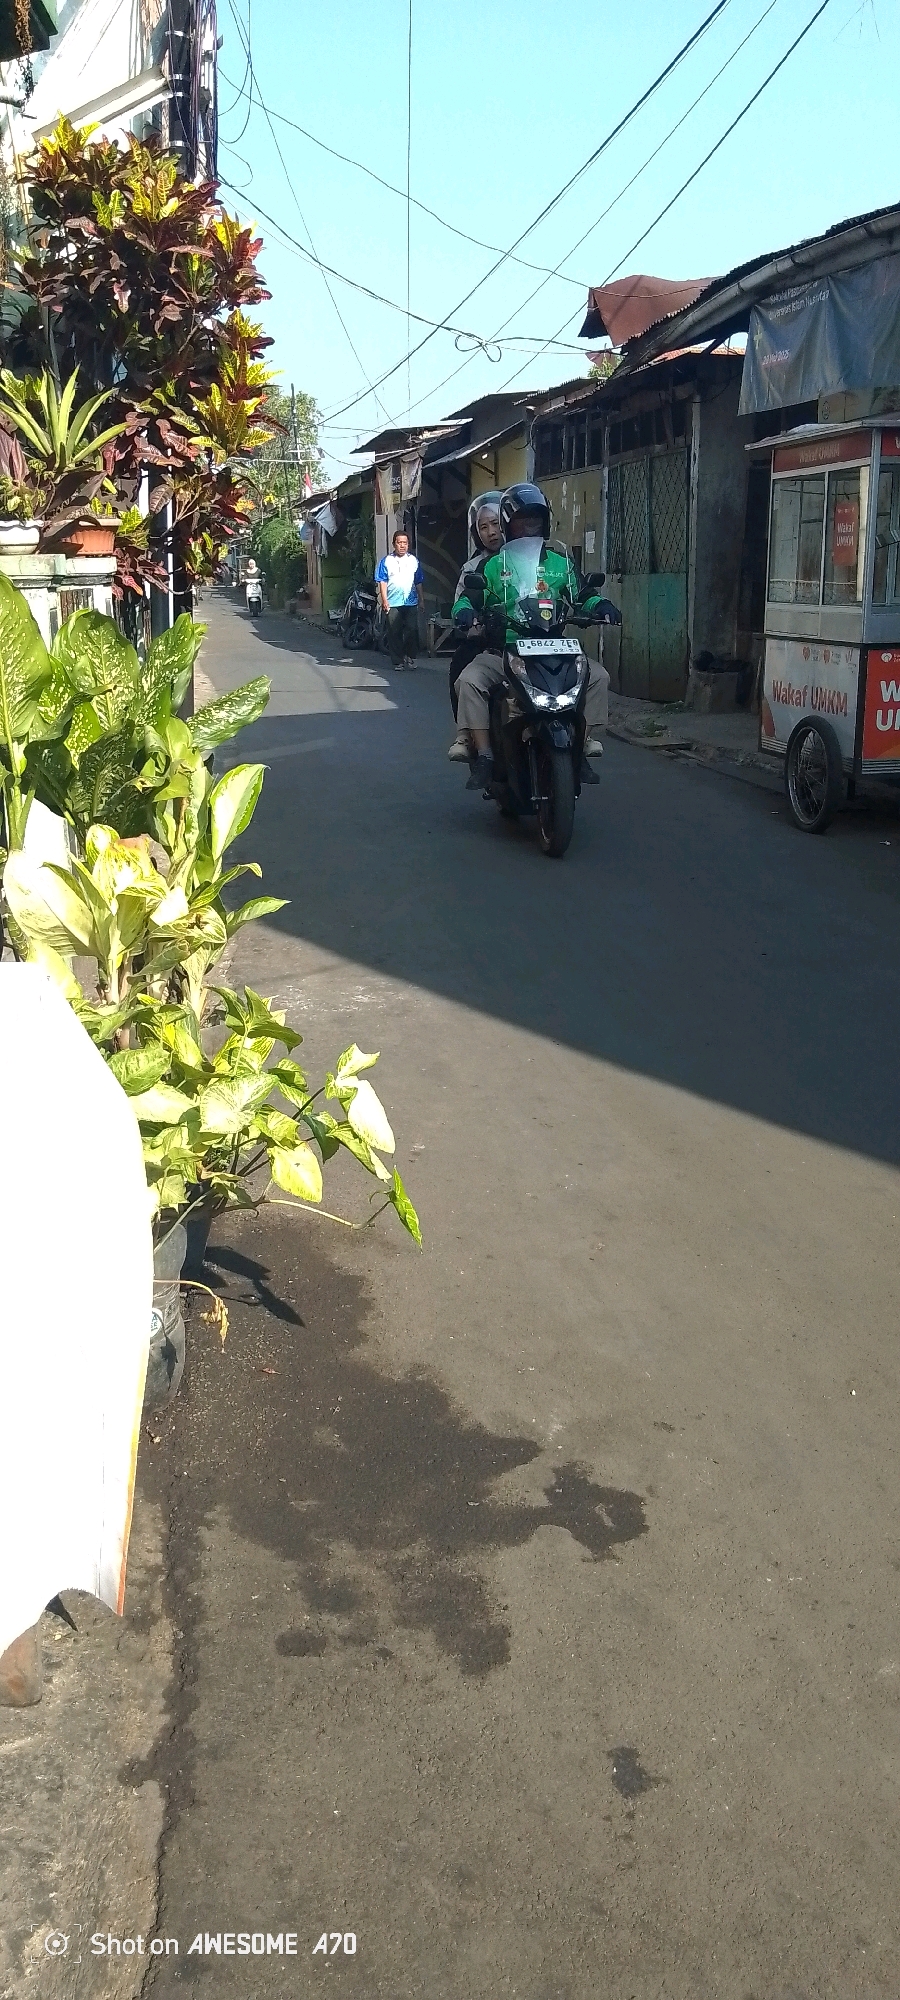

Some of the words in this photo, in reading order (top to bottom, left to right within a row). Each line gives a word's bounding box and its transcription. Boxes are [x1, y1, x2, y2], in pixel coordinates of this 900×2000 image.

[800, 447, 817, 463] Wakaf
[818, 443, 840, 460] UMKM
[837, 521, 855, 533] Wakaf
[836, 535, 854, 547] UMKM
[772, 679, 808, 708] Wakaf
[811, 686, 848, 717] UMKM
